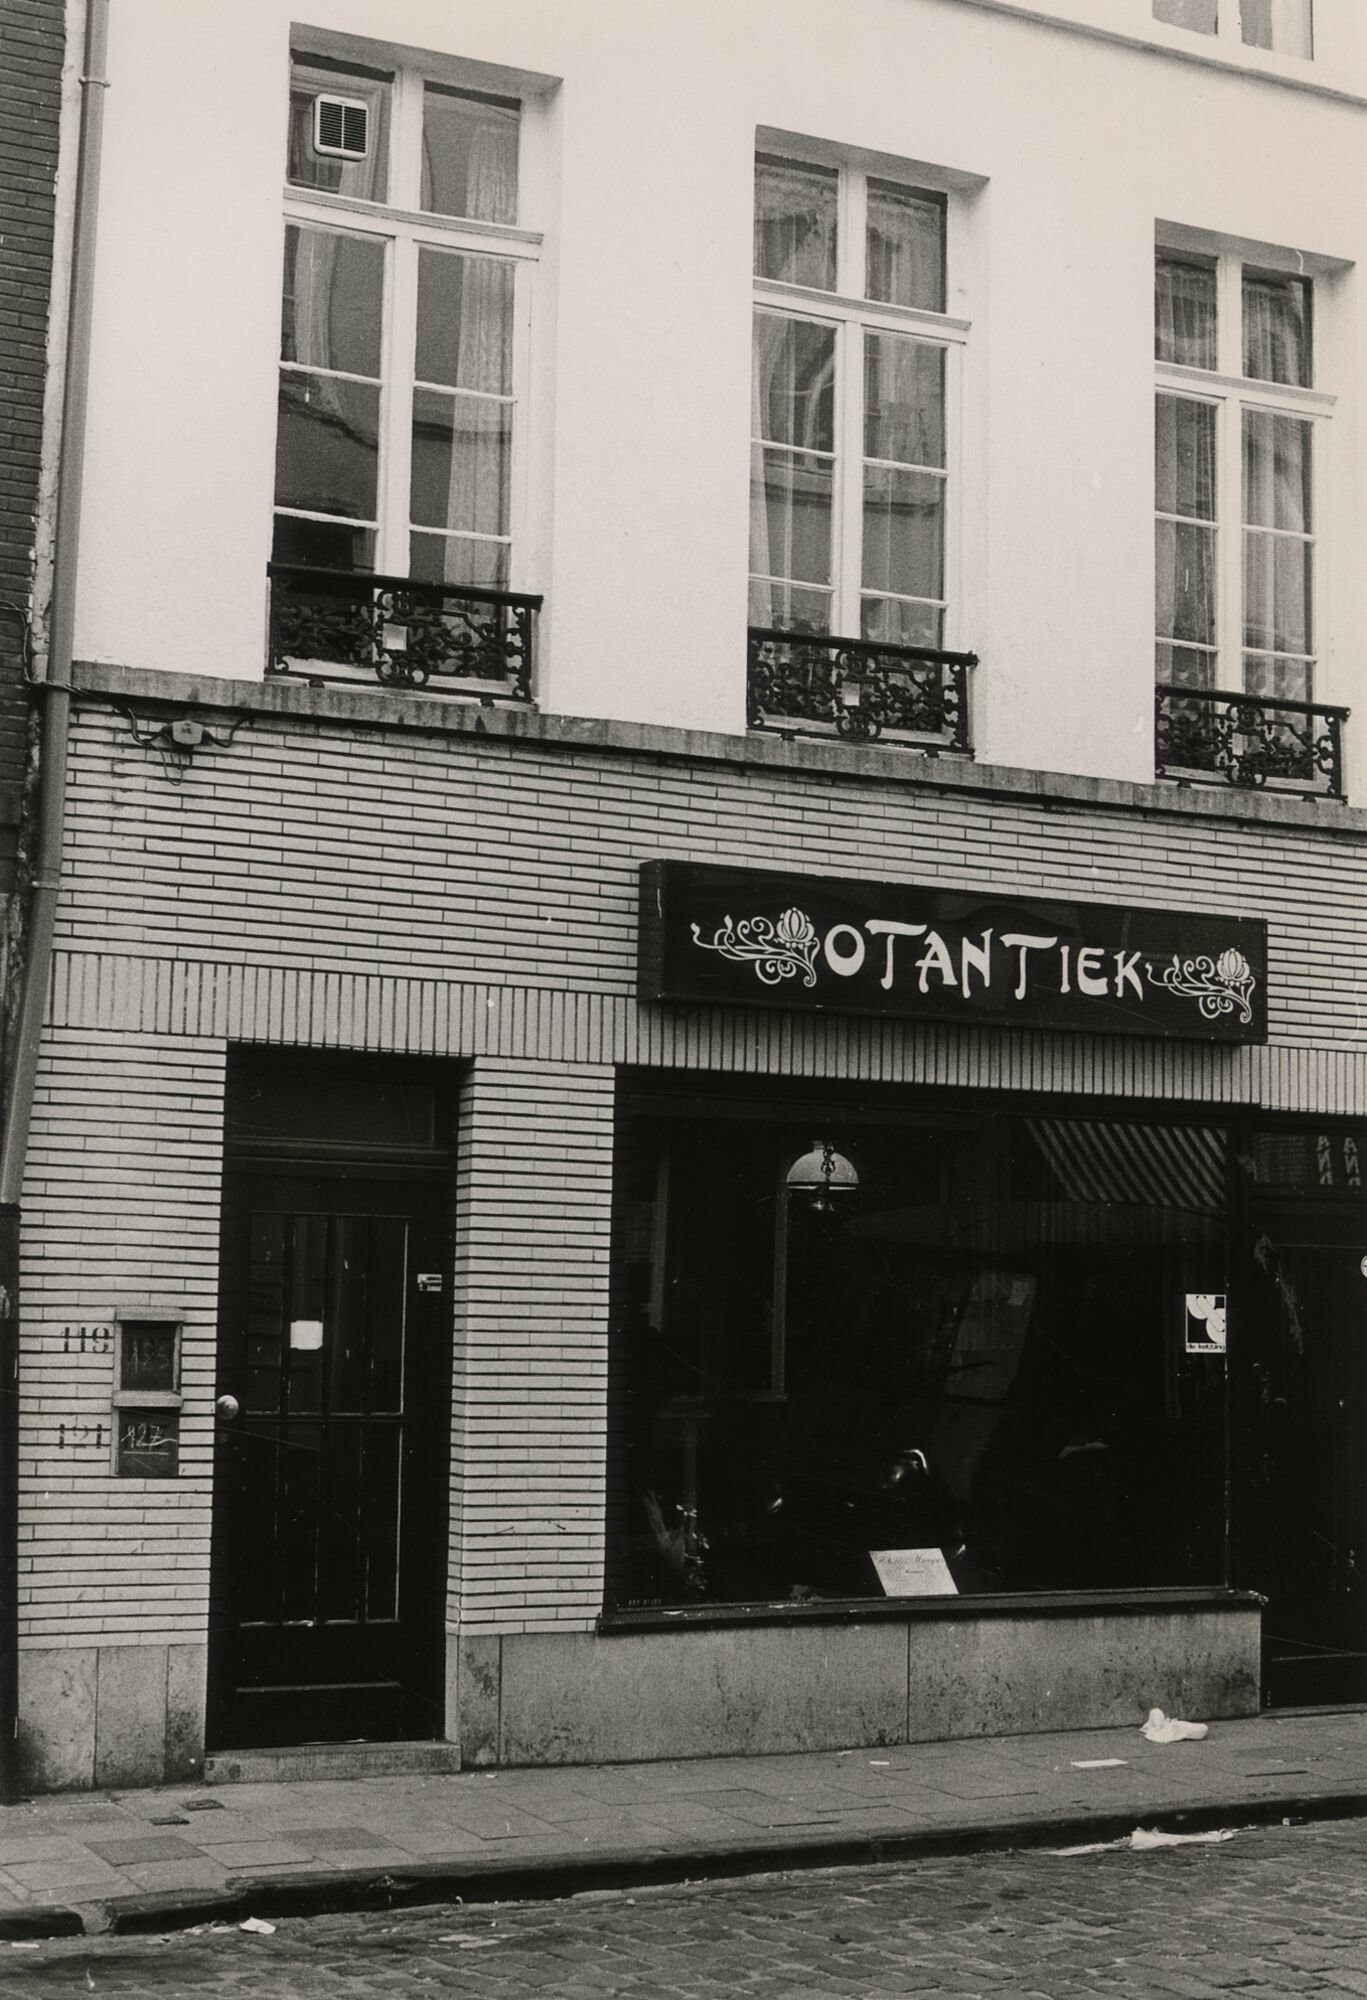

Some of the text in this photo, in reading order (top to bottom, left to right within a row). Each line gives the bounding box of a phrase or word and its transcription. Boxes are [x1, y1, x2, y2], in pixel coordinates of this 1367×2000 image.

[824, 919, 1144, 1001] OTANTIEK
[63, 1327, 109, 1353] 119
[60, 1423, 103, 1449] 121
